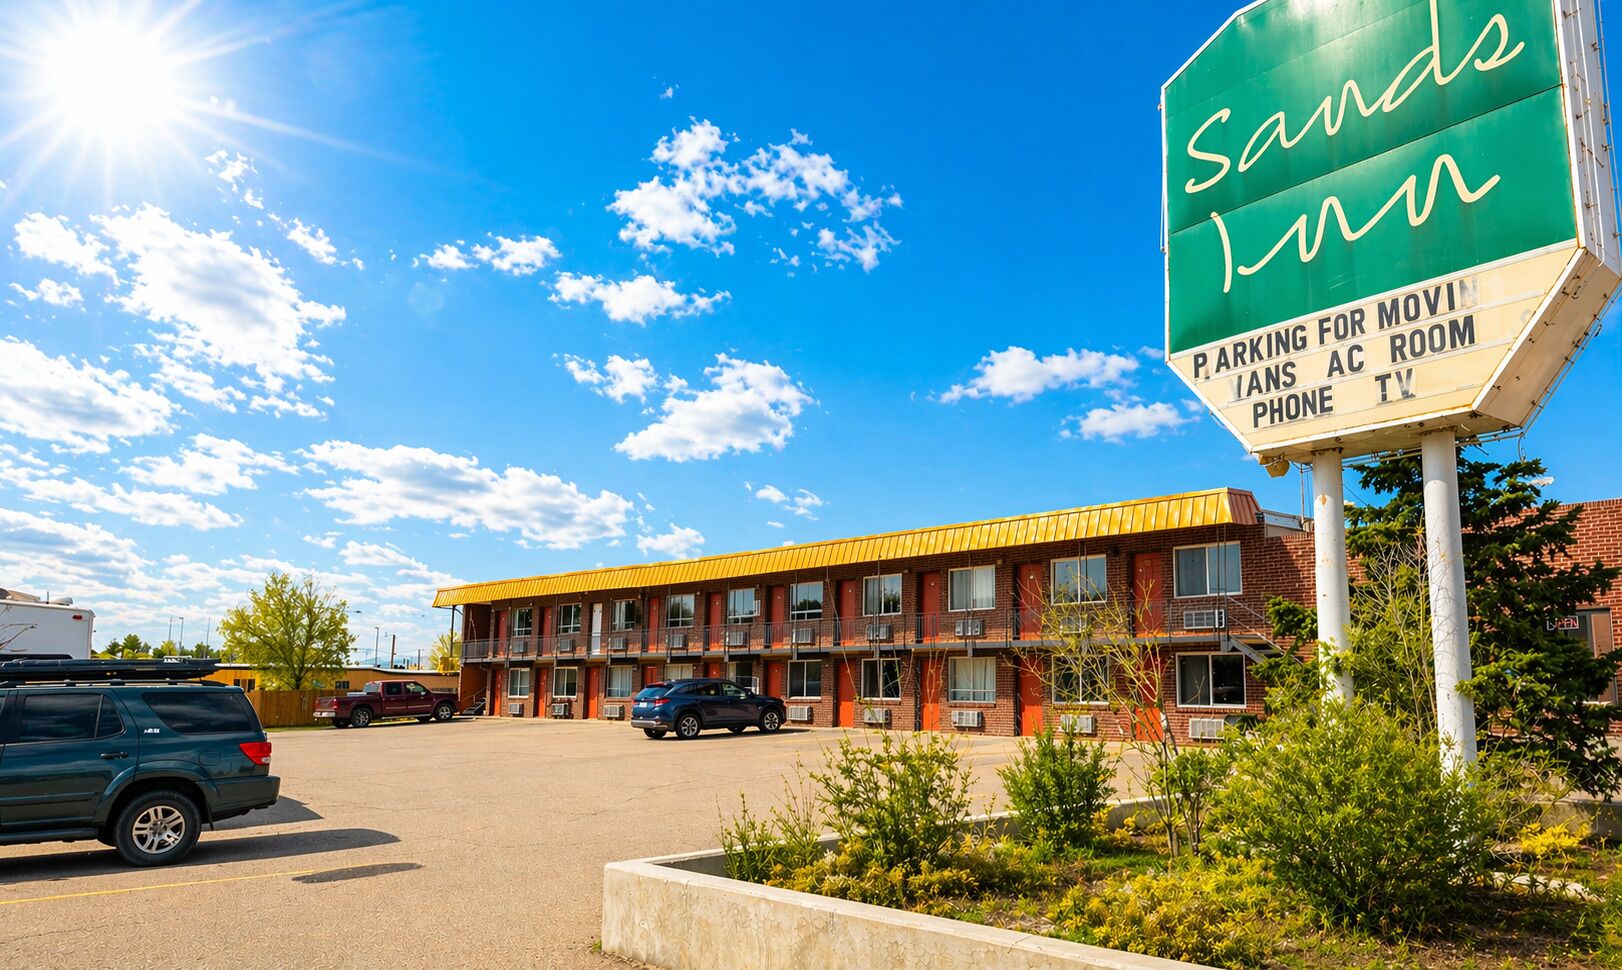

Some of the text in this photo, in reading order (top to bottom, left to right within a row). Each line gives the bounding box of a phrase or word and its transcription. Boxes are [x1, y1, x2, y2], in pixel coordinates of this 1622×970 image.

[1185, 0, 1526, 194] Sands
[1210, 154, 1501, 293] Inn
[1193, 324, 1307, 379] PARKING
[1318, 308, 1365, 345] FOR
[1327, 344, 1364, 377] AC
[1389, 314, 1475, 363] ROOM
[1253, 367, 1413, 428] PHONE TV
